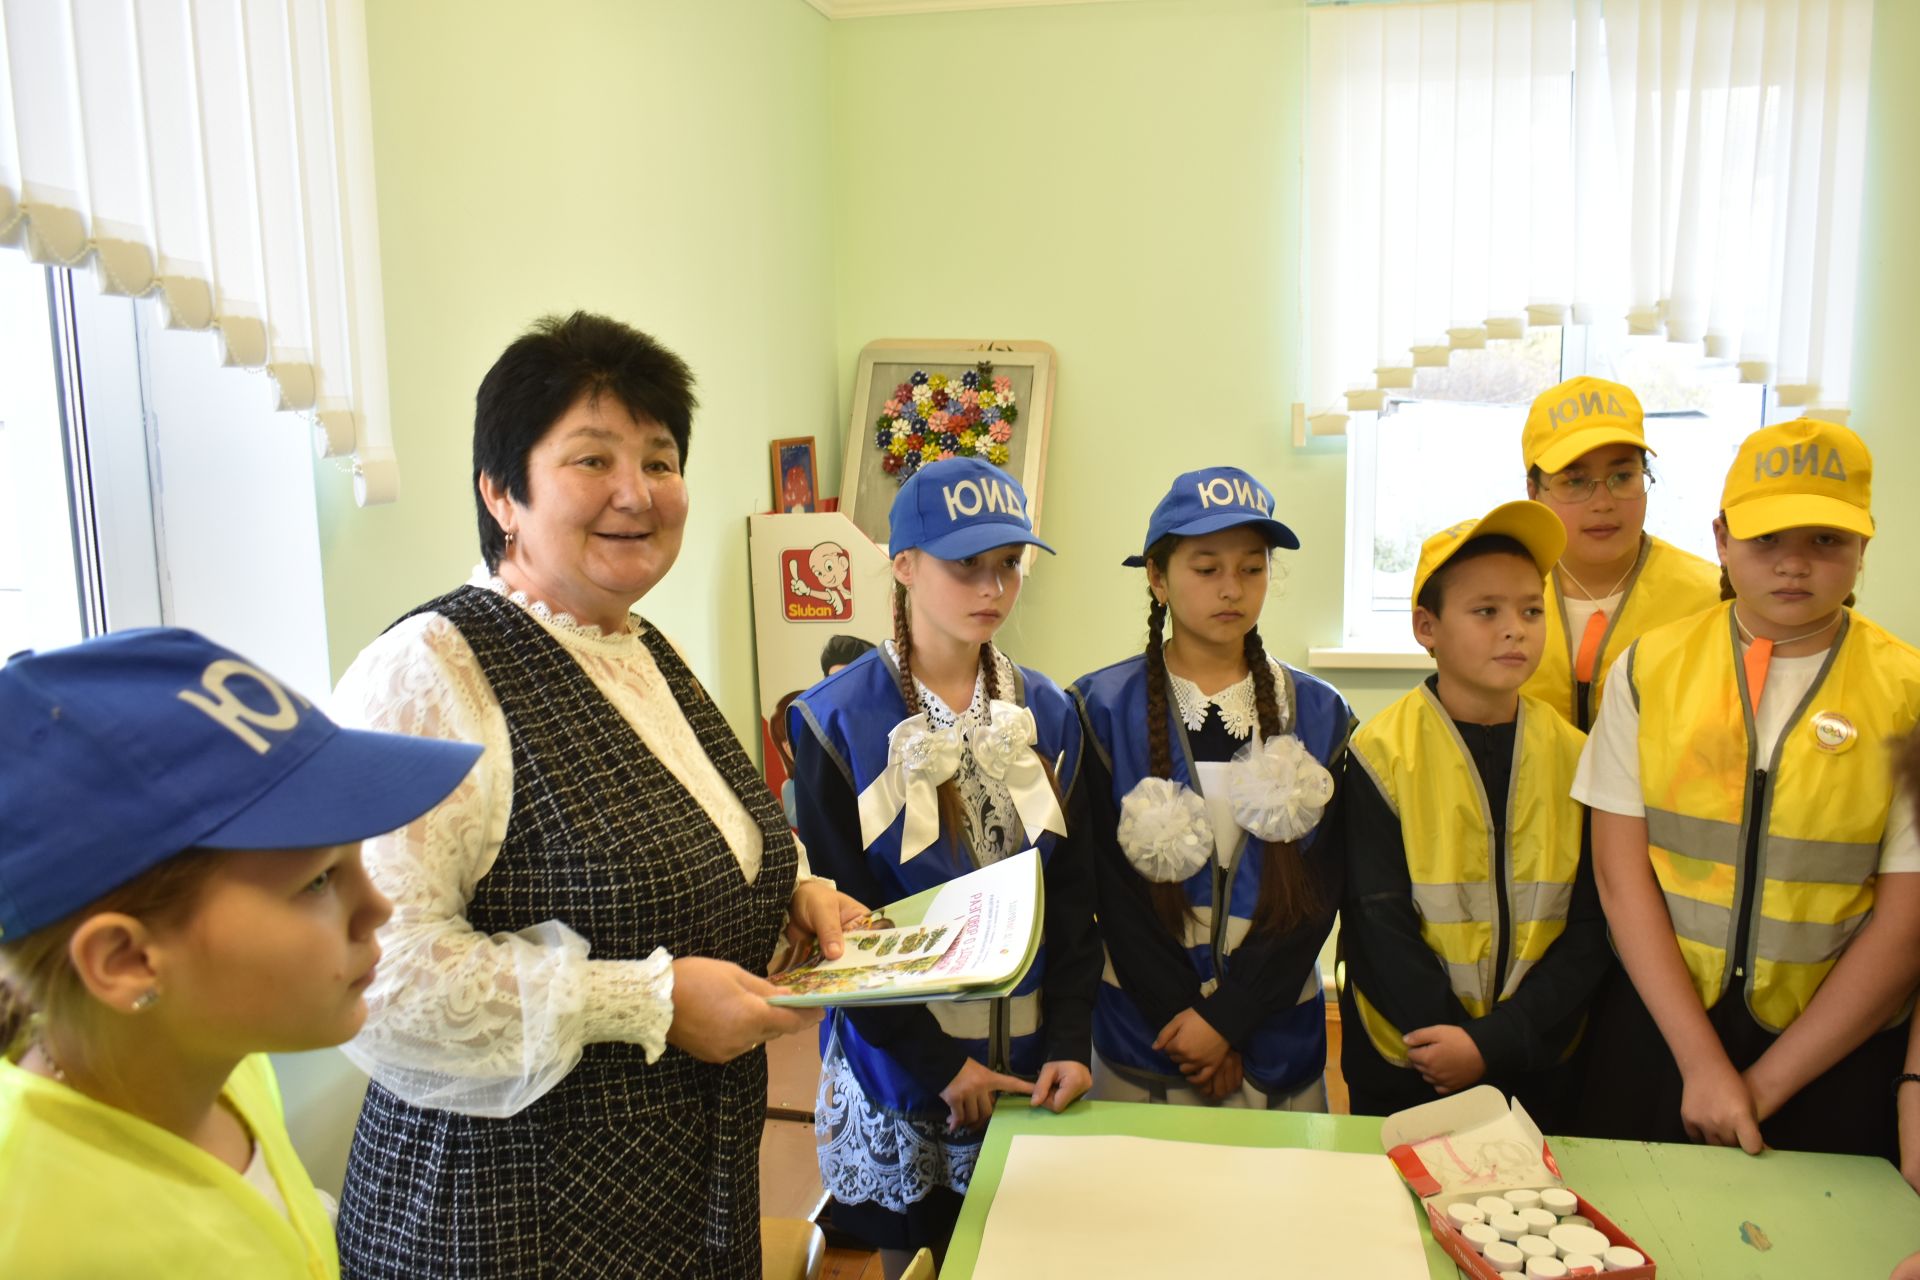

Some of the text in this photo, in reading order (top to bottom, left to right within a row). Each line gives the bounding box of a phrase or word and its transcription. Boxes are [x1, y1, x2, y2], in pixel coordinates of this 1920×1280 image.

[1548, 391, 1627, 432] ЮИД
[1754, 443, 1846, 482] ЮИД
[943, 478, 1025, 520] ЮИД
[1198, 478, 1268, 514] ЮИД
[788, 603, 832, 617] Sluban
[177, 659, 312, 755] Ю
